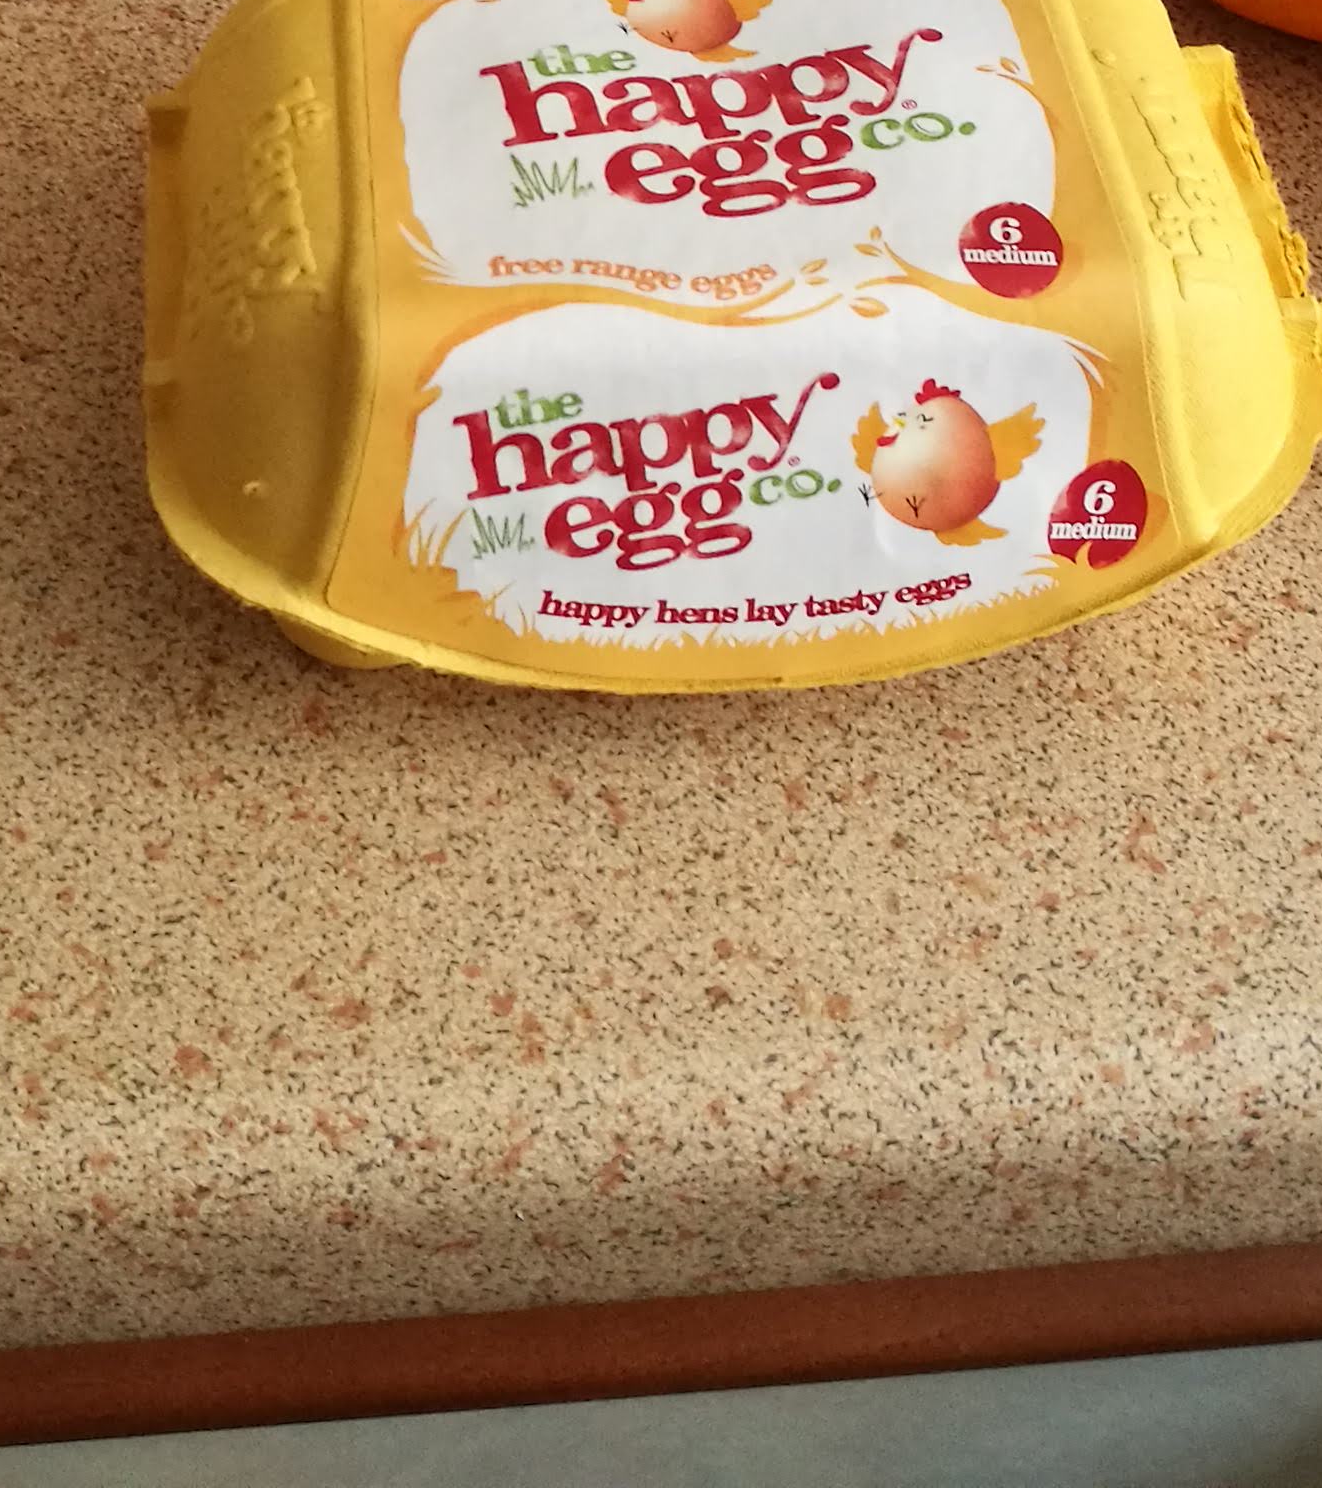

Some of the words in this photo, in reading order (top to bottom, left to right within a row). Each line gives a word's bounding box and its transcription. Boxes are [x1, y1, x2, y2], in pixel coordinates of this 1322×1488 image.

[529, 43, 639, 79] the
[479, 27, 944, 148] happy
[603, 112, 878, 219] egg
[859, 109, 978, 152] co.
[988, 214, 1024, 246] 6
[487, 253, 567, 282] free
[570, 255, 684, 297] range
[688, 258, 778, 301] eggs
[963, 241, 1059, 268] medium
[492, 386, 585, 431] the
[451, 371, 841, 502] happy
[543, 466, 752, 573] egg
[747, 465, 842, 507] co.
[1081, 478, 1117, 516] 6
[1049, 515, 1138, 543] medium
[538, 587, 651, 628] happy
[654, 597, 740, 625] hens
[743, 596, 798, 627] lay
[804, 586, 889, 619] tasty
[894, 571, 973, 606] eggs
